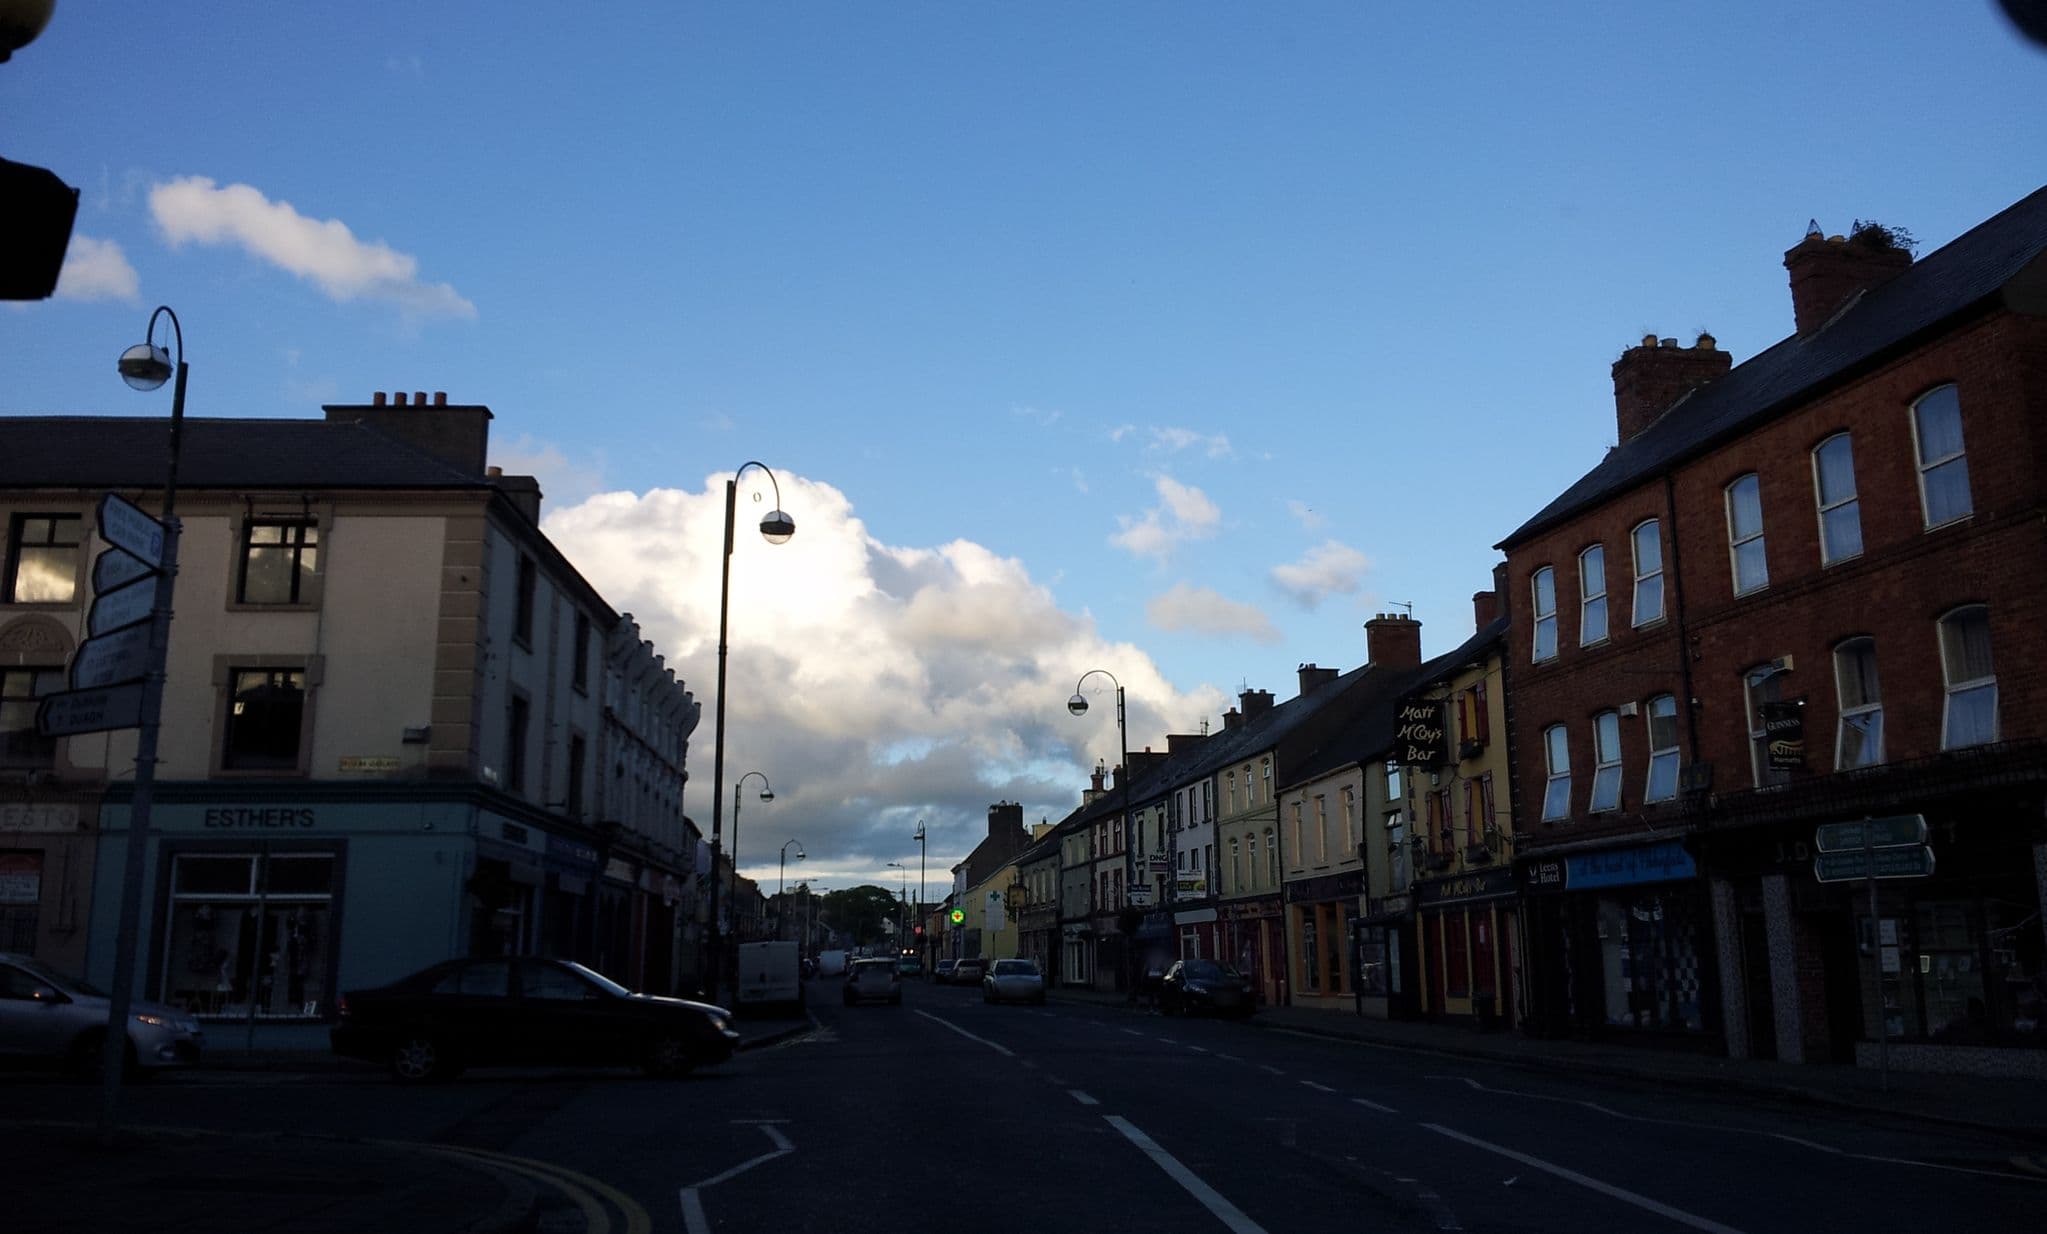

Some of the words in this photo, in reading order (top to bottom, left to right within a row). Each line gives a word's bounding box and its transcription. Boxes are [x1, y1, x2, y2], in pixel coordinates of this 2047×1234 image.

[1399, 705, 1436, 720] Matt
[1406, 744, 1437, 761] Bar
[204, 808, 315, 828] ESTHER'S
